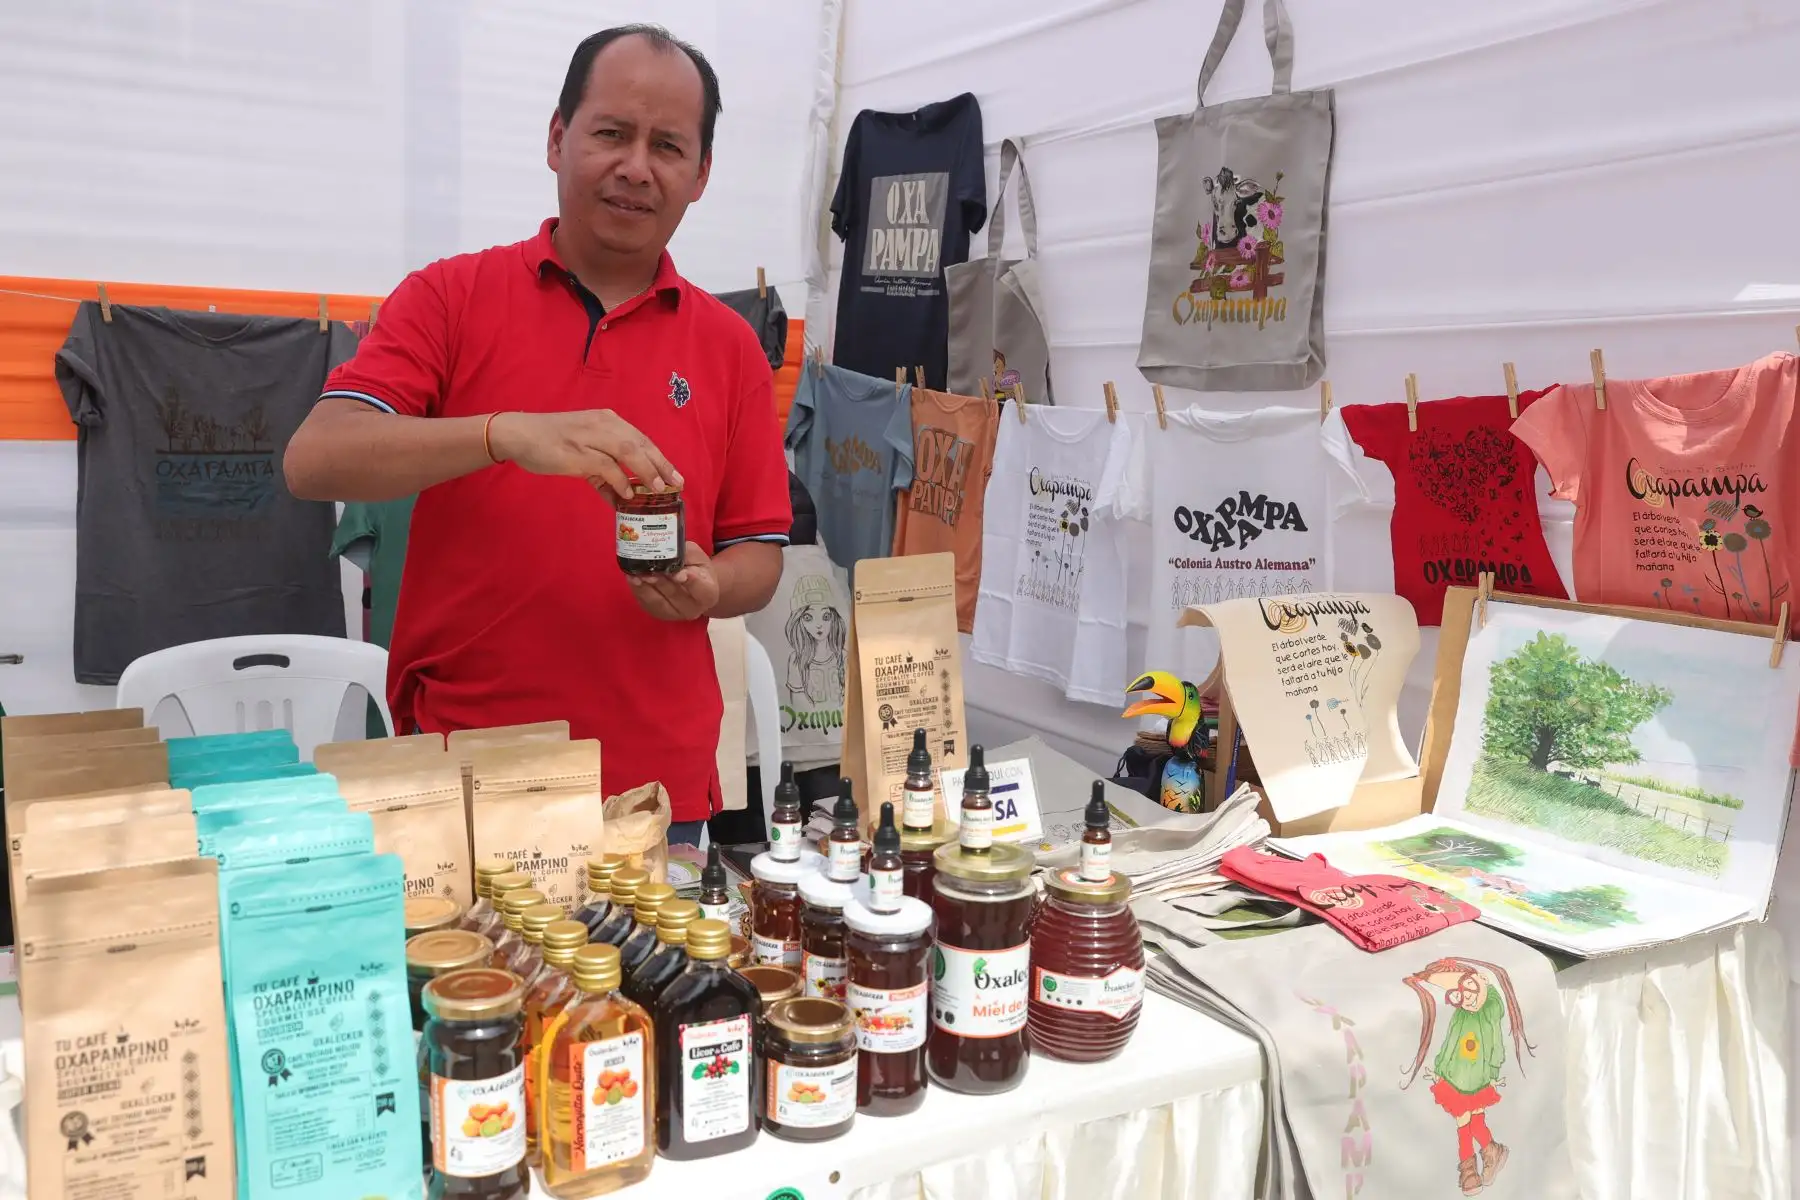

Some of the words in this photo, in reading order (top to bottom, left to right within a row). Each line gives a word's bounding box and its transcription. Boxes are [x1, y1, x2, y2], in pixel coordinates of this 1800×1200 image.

[886, 180, 929, 224] OXA
[869, 227, 939, 273] PAMPA
[915, 426, 975, 490] OXA
[1214, 557, 1253, 570] Austro
[1636, 562, 1675, 572] mañana
[1258, 597, 1371, 631] Oxapampa
[1303, 632, 1327, 644] verde
[874, 657, 884, 666] TU
[1275, 654, 1292, 664] que
[1292, 647, 1321, 659] cortes
[875, 660, 935, 678] OXAPAMPINO
[1277, 663, 1296, 675] será
[1324, 655, 1341, 665] que
[1285, 685, 1318, 698] mañana
[995, 798, 1018, 821] SA
[507, 850, 528, 860] CAFÉ
[516, 857, 568, 872] PAMPINO
[407, 888, 435, 897] COFFEE
[253, 981, 267, 994] TU
[253, 979, 355, 1010] OXAPAMPINO
[973, 1002, 1005, 1017] Miel
[1008, 997, 1022, 1013] de
[55, 1040, 71, 1052] TU
[55, 1038, 169, 1070] OXAPAMPINO
[691, 1046, 715, 1059] Licor
[720, 1040, 741, 1053] Café
